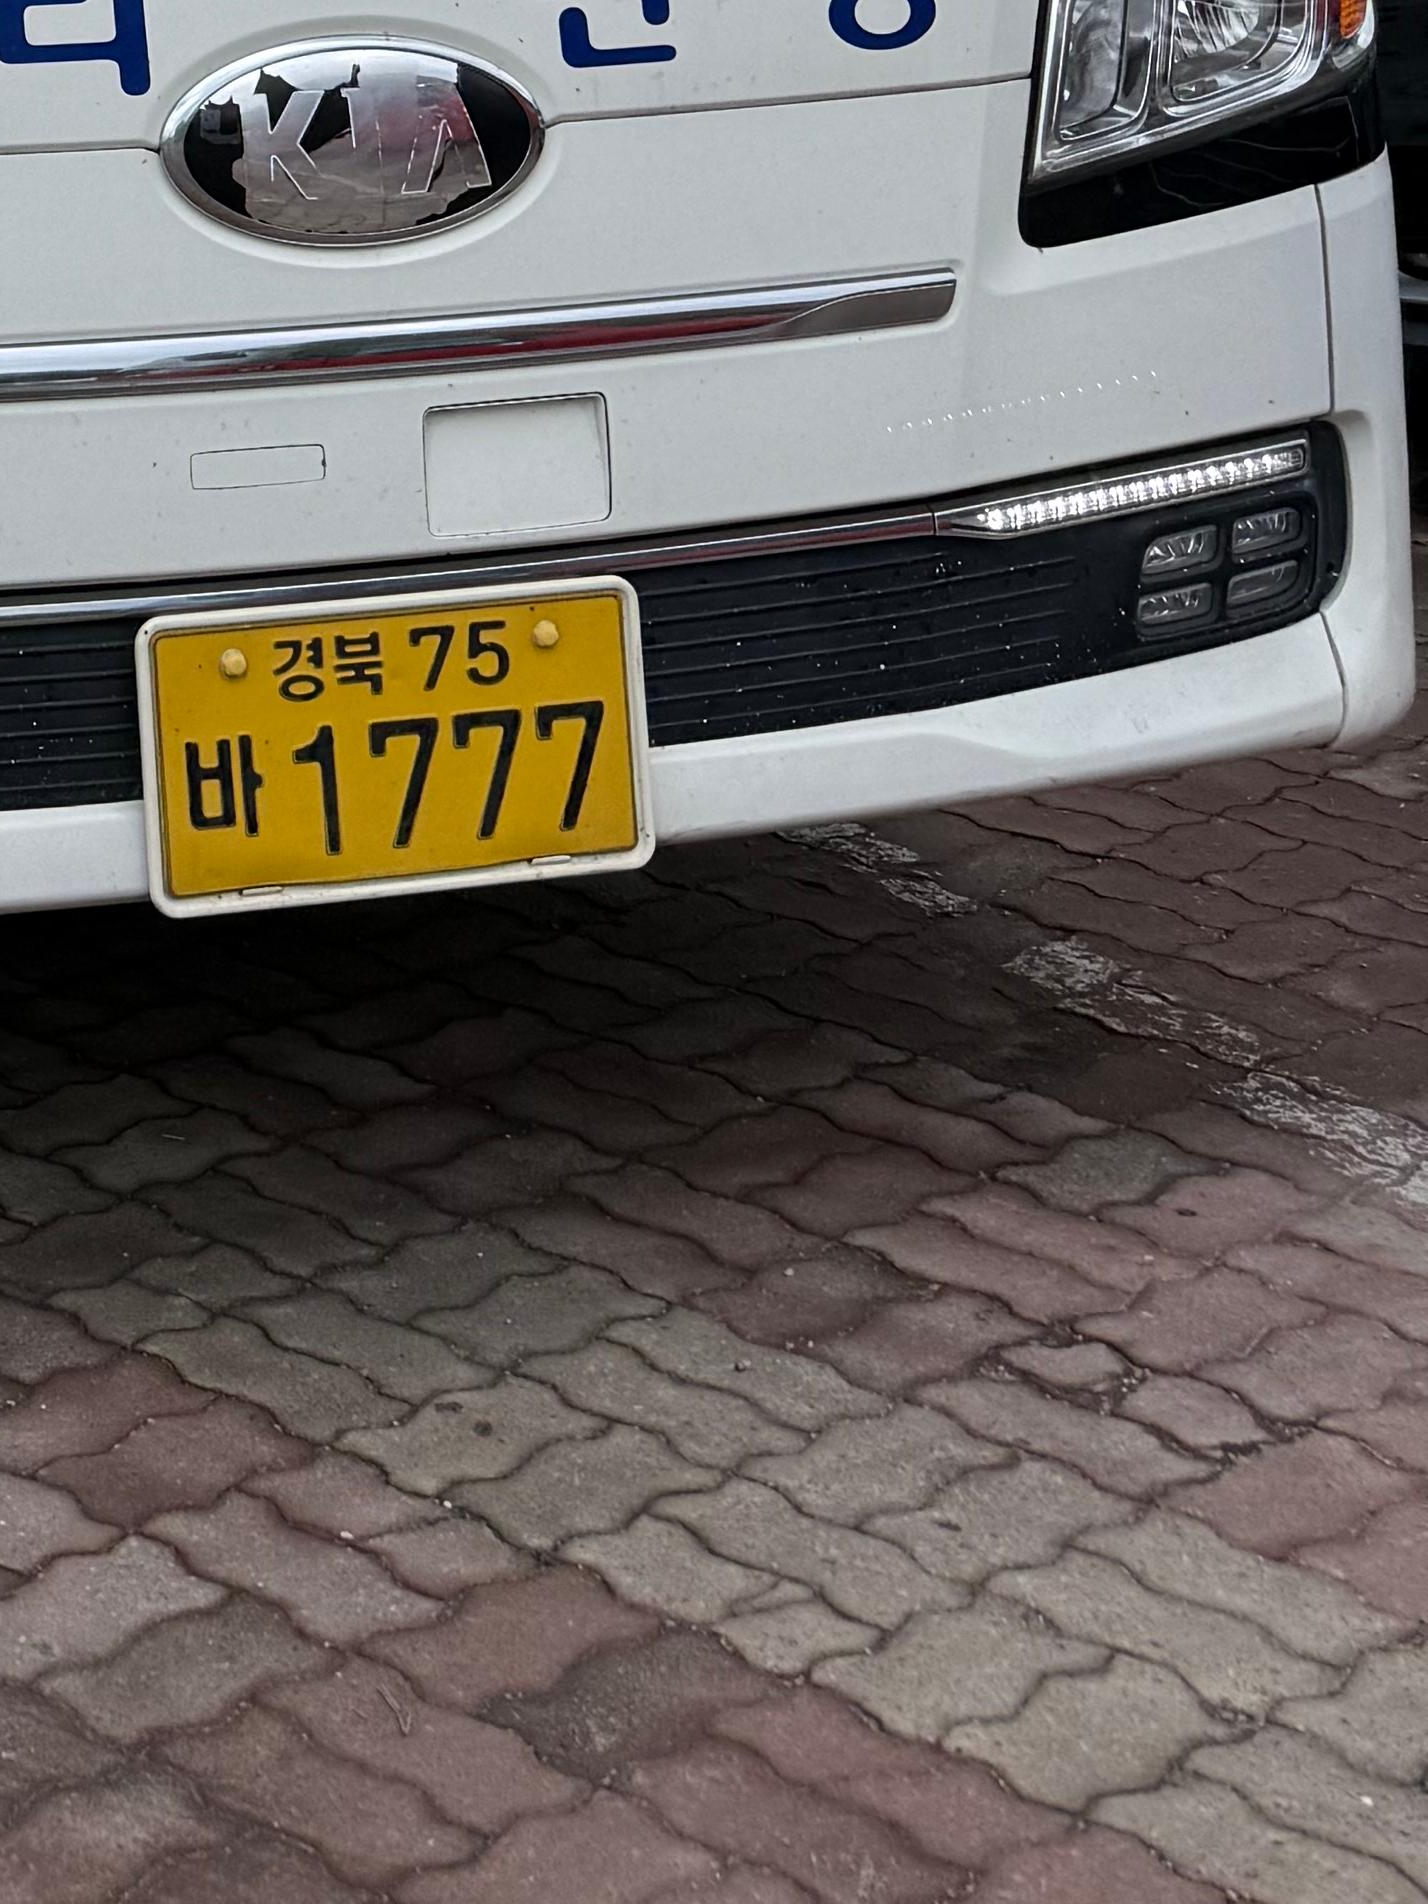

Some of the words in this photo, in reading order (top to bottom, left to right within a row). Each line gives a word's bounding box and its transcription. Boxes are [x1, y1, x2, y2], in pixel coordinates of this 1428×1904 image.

[240, 88, 492, 200] KIA
[272, 630, 384, 703] 경북
[408, 619, 511, 692] 75
